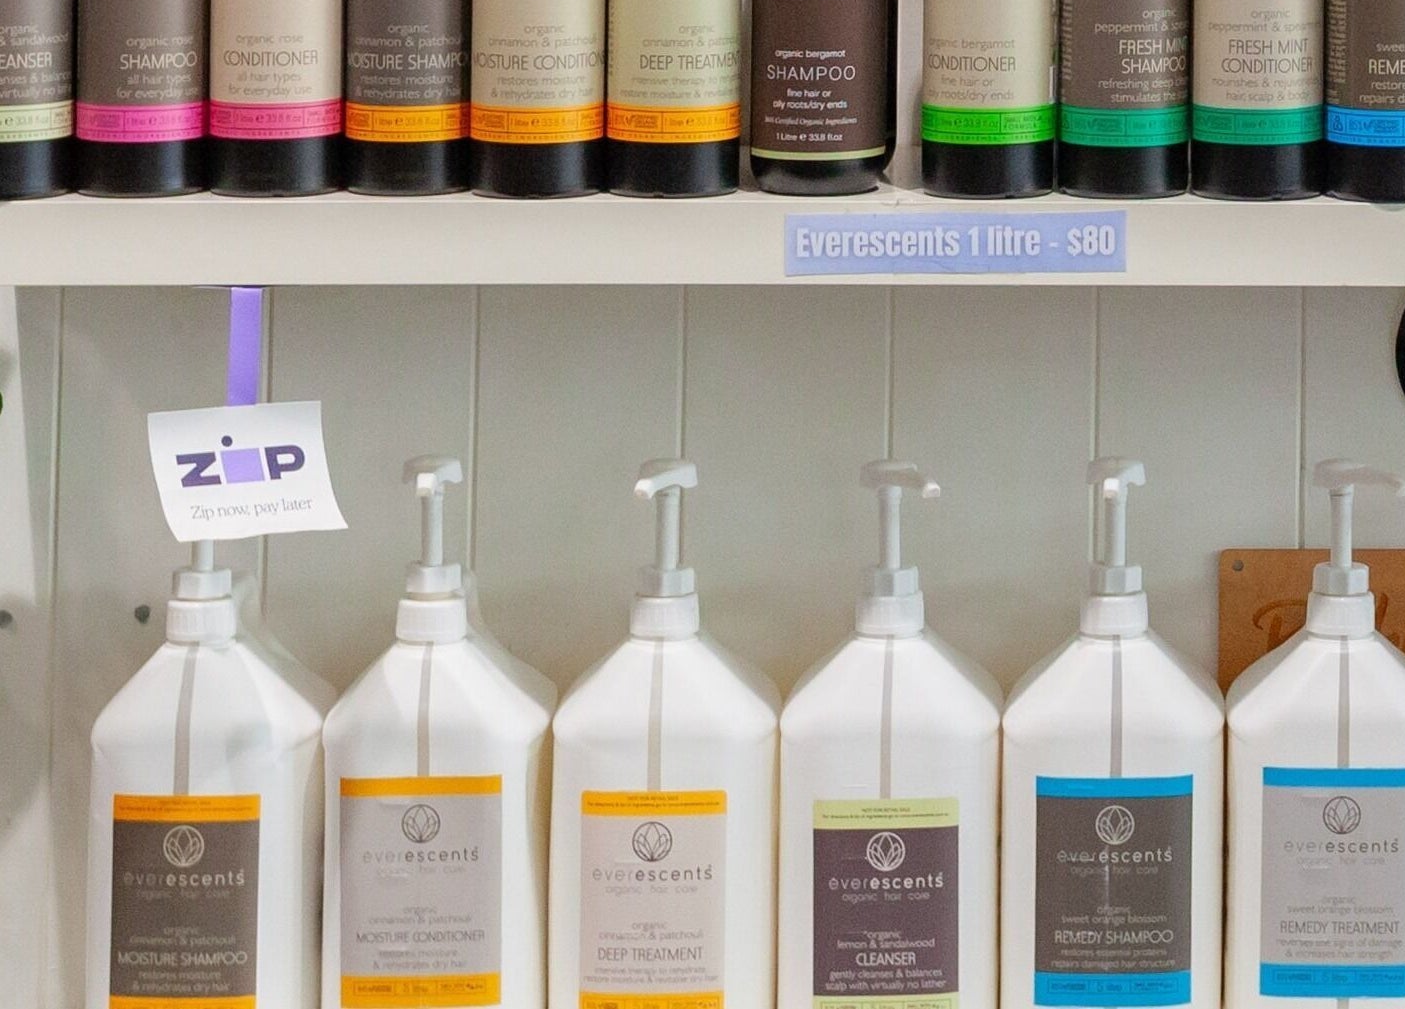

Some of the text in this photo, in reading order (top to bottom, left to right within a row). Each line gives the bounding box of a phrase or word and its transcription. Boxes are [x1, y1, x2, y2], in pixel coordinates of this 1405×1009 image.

[774, 49, 846, 60] organic bergamot
[1228, 39, 1310, 56] FRESH MINT
[120, 50, 198, 70] SHAMPOO
[223, 48, 319, 68] CONDITIONER
[639, 52, 742, 71] DEEP TREATMEN
[926, 55, 1017, 75] CONDITIONER
[1120, 57, 1186, 74] SHAMPOO
[1220, 58, 1314, 75] CONDITIONER
[766, 63, 857, 82] SHAMPOO
[796, 227, 961, 258] Everescents
[967, 226, 980, 257] 1
[986, 225, 1041, 256] litre
[1066, 223, 1116, 258] $80
[190, 497, 314, 521] Zip now, pay later
[1283, 839, 1400, 855] everescents
[363, 848, 480, 865] everescents
[592, 865, 714, 883] everescents
[828, 874, 945, 891] everescents
[1279, 920, 1400, 935] REMEDY TREATMENT
[356, 929, 486, 944] MOISTURE CONDITIONER
[1054, 930, 1174, 946] REMEDY SHAMPOO
[117, 950, 249, 967] MOISTURE SHAMPOO
[597, 945, 703, 963] DEEP TREATMENT
[855, 951, 917, 967] CLEANSER
